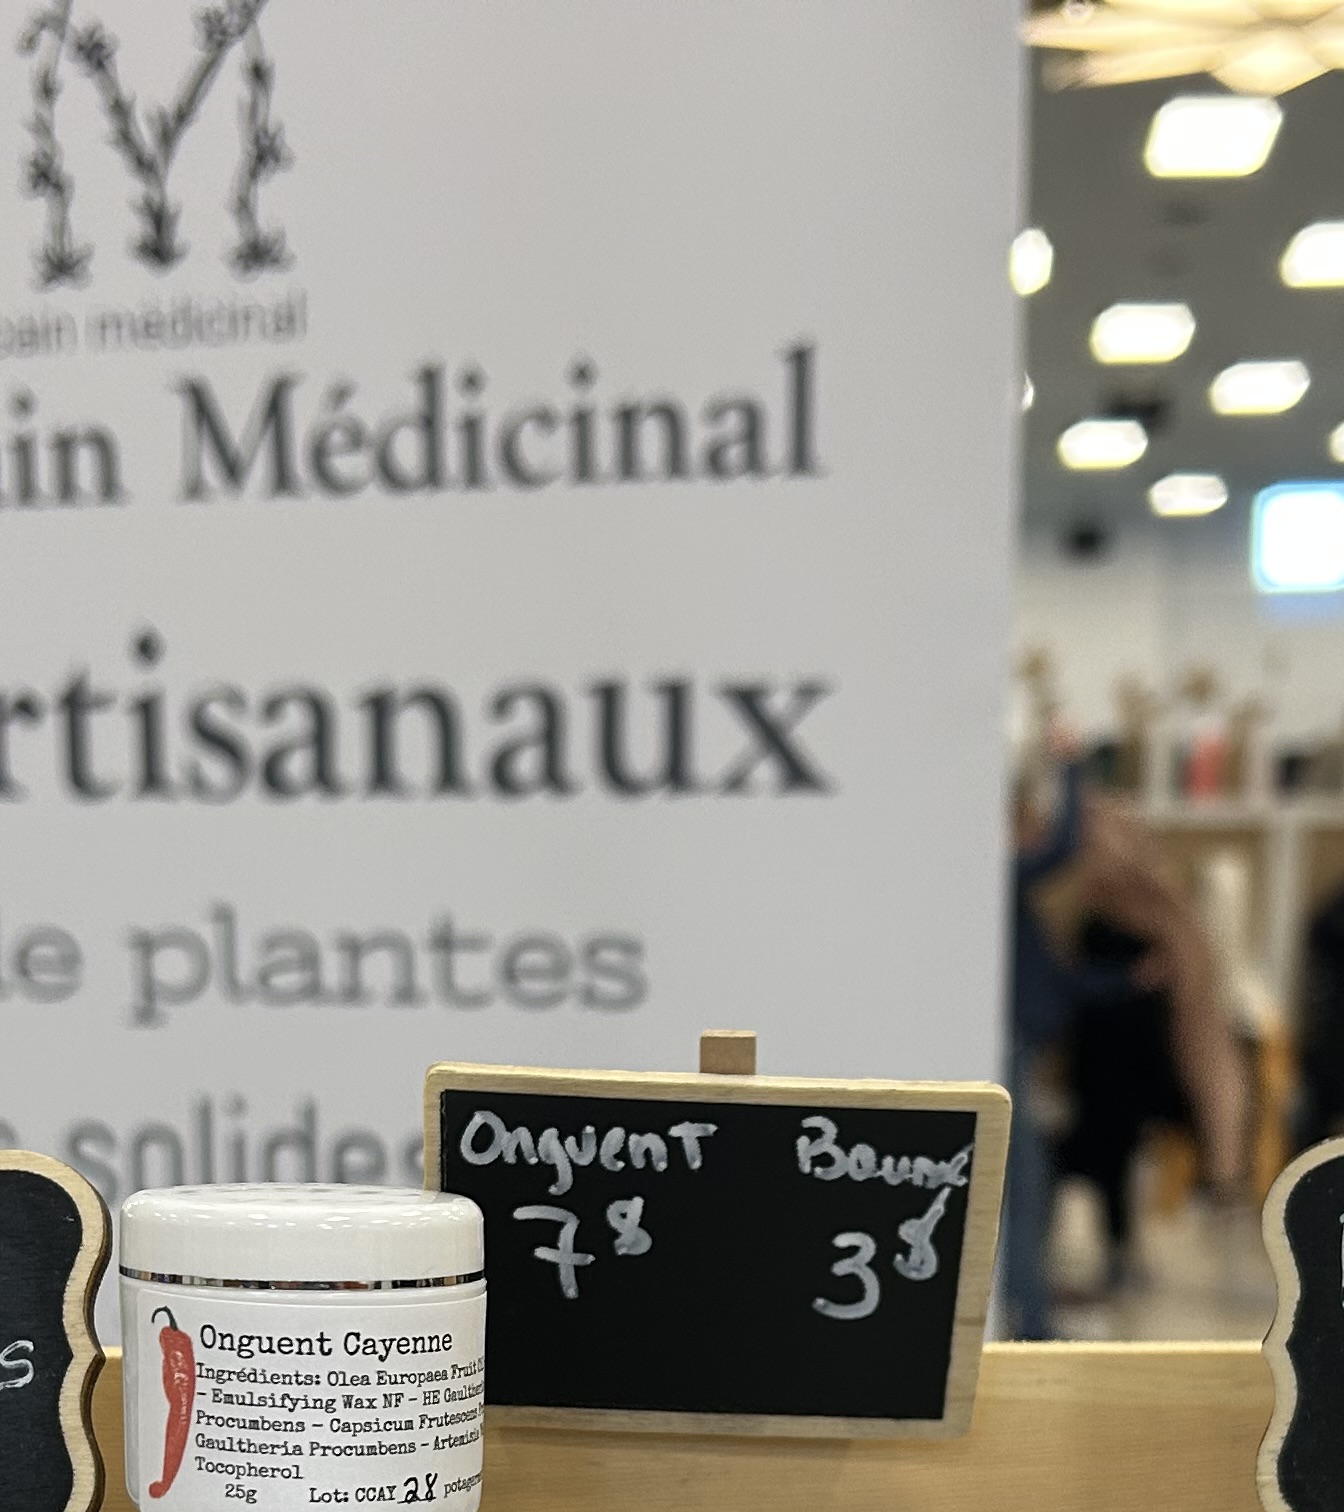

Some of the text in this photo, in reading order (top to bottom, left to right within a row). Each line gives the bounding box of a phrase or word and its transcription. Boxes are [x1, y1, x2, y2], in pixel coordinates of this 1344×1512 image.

[174, 333, 833, 503] Médicinal
[128, 902, 649, 1030] plantes
[461, 1110, 718, 1195] Onguent
[200, 1325, 452, 1361] Onguent Cayenne
[196, 1363, 320, 1386] Ingrédients:
[328, 1371, 370, 1386] Olea
[377, 1367, 448, 1387] Europaea
[212, 1389, 336, 1413] Emulsifying
[342, 1394, 377, 1409] Wax
[383, 1393, 404, 1408] NF
[423, 1390, 439, 1406] HE
[196, 1410, 305, 1432] Procumbens
[330, 1418, 413, 1436] Capsicum
[196, 1434, 303, 1456] Gaultheria
[309, 1440, 416, 1457] Procumbens
[195, 1457, 303, 1479] Tocopherol
[225, 1484, 257, 1503] 25g
[309, 1488, 348, 1503] Lot:
